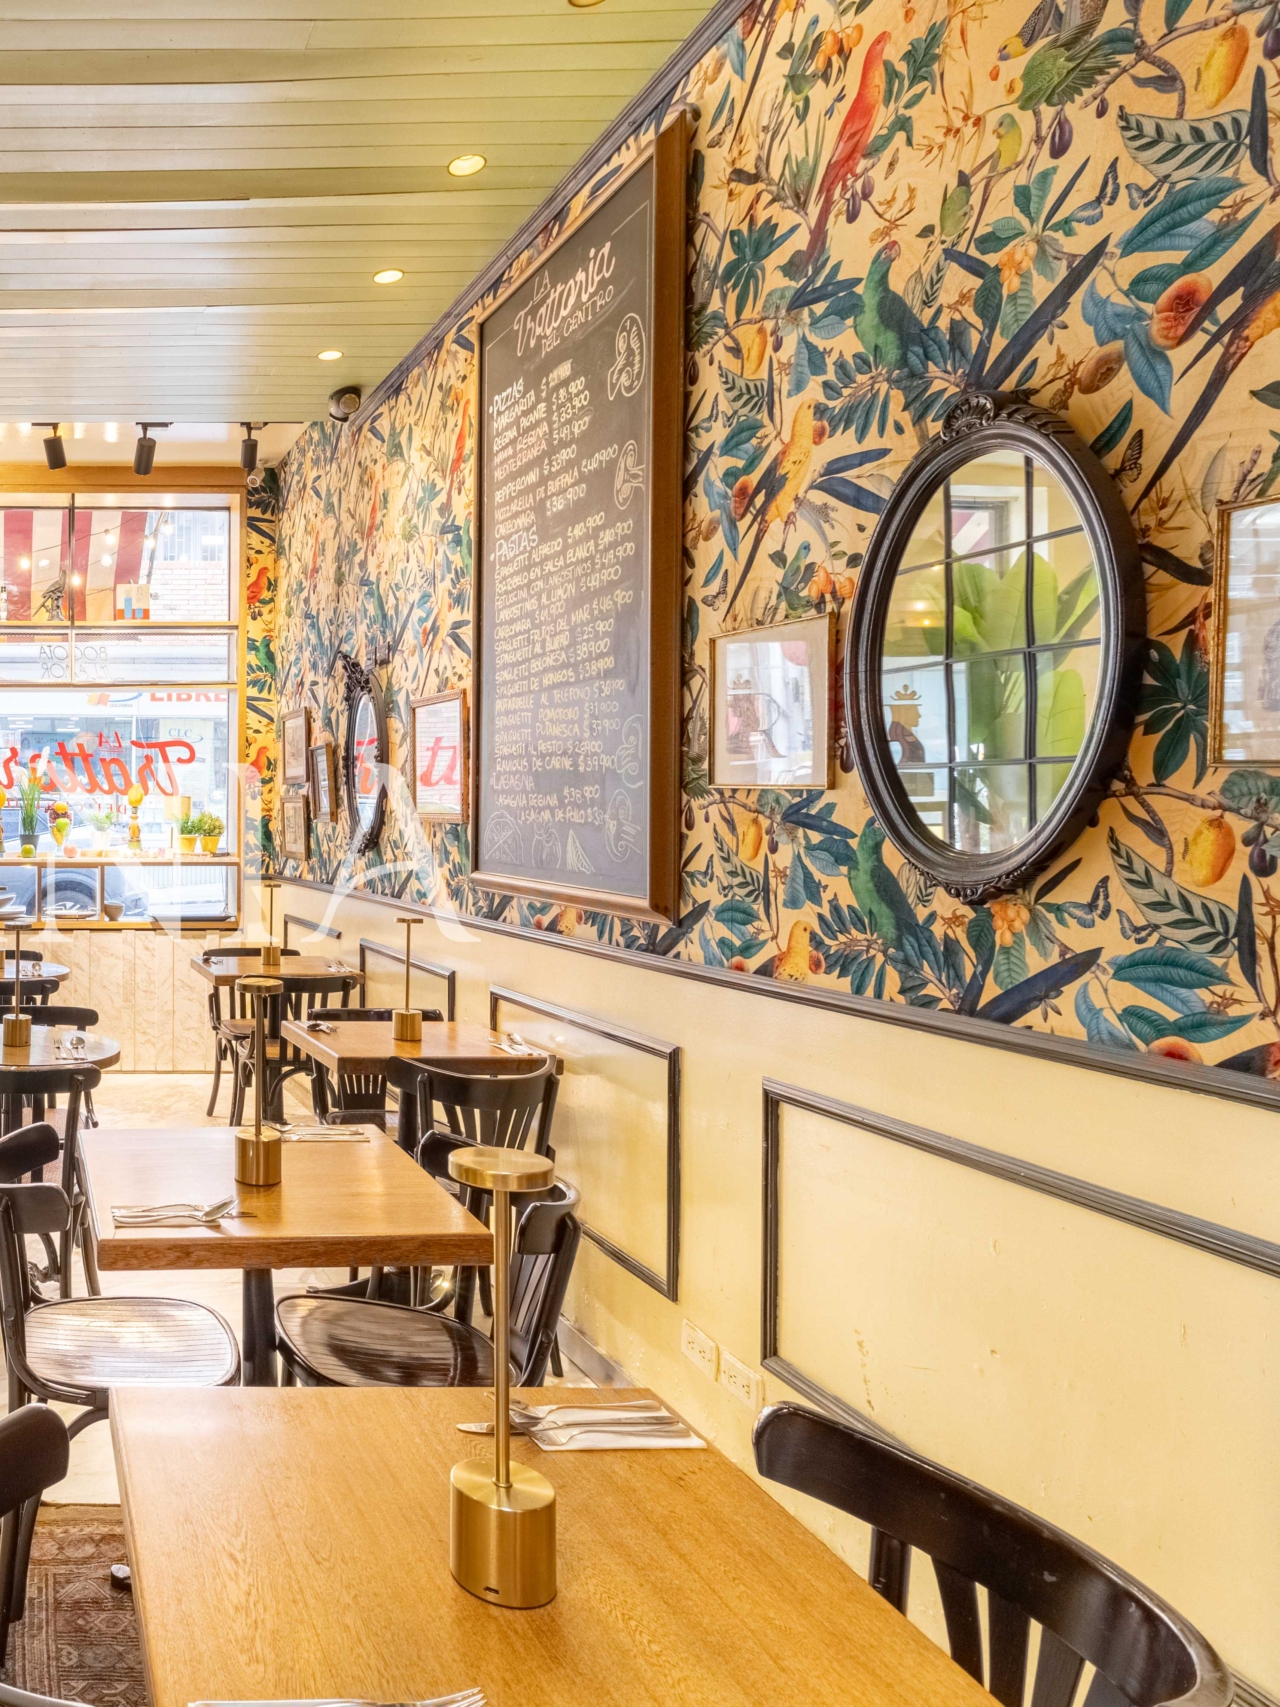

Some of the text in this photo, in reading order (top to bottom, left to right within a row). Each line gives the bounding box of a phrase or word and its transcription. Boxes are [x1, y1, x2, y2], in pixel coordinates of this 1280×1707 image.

[533, 269, 551, 302] LA
[513, 240, 616, 357] Trattoria
[541, 285, 614, 358] DEL CENTRO
[493, 376, 524, 420] PIZZAS
[493, 389, 535, 436] MARGARITA
[494, 425, 518, 454] REGINA
[520, 402, 547, 433] PICANTE
[517, 421, 549, 453] REGINA
[494, 439, 547, 482] MEDITERRANEA
[494, 510, 536, 538] CARBONARA
[495, 524, 538, 571] PASTAS
[529, 565, 540, 580] EN
[542, 555, 564, 574] SALSA
[571, 604, 590, 626] MAR
[494, 618, 531, 640] CARBONARA
[530, 677, 539, 690] DE
[540, 692, 549, 705] AL
[168, 727, 193, 738] CLC
[538, 740, 563, 755] PESTO
[532, 758, 542, 772] DE
[545, 755, 574, 771] CARNE
[493, 772, 535, 790] LASAGNA
[495, 793, 527, 807] LASAGNA
[528, 793, 558, 807] REGINA
[517, 809, 552, 825] LASAGNA
